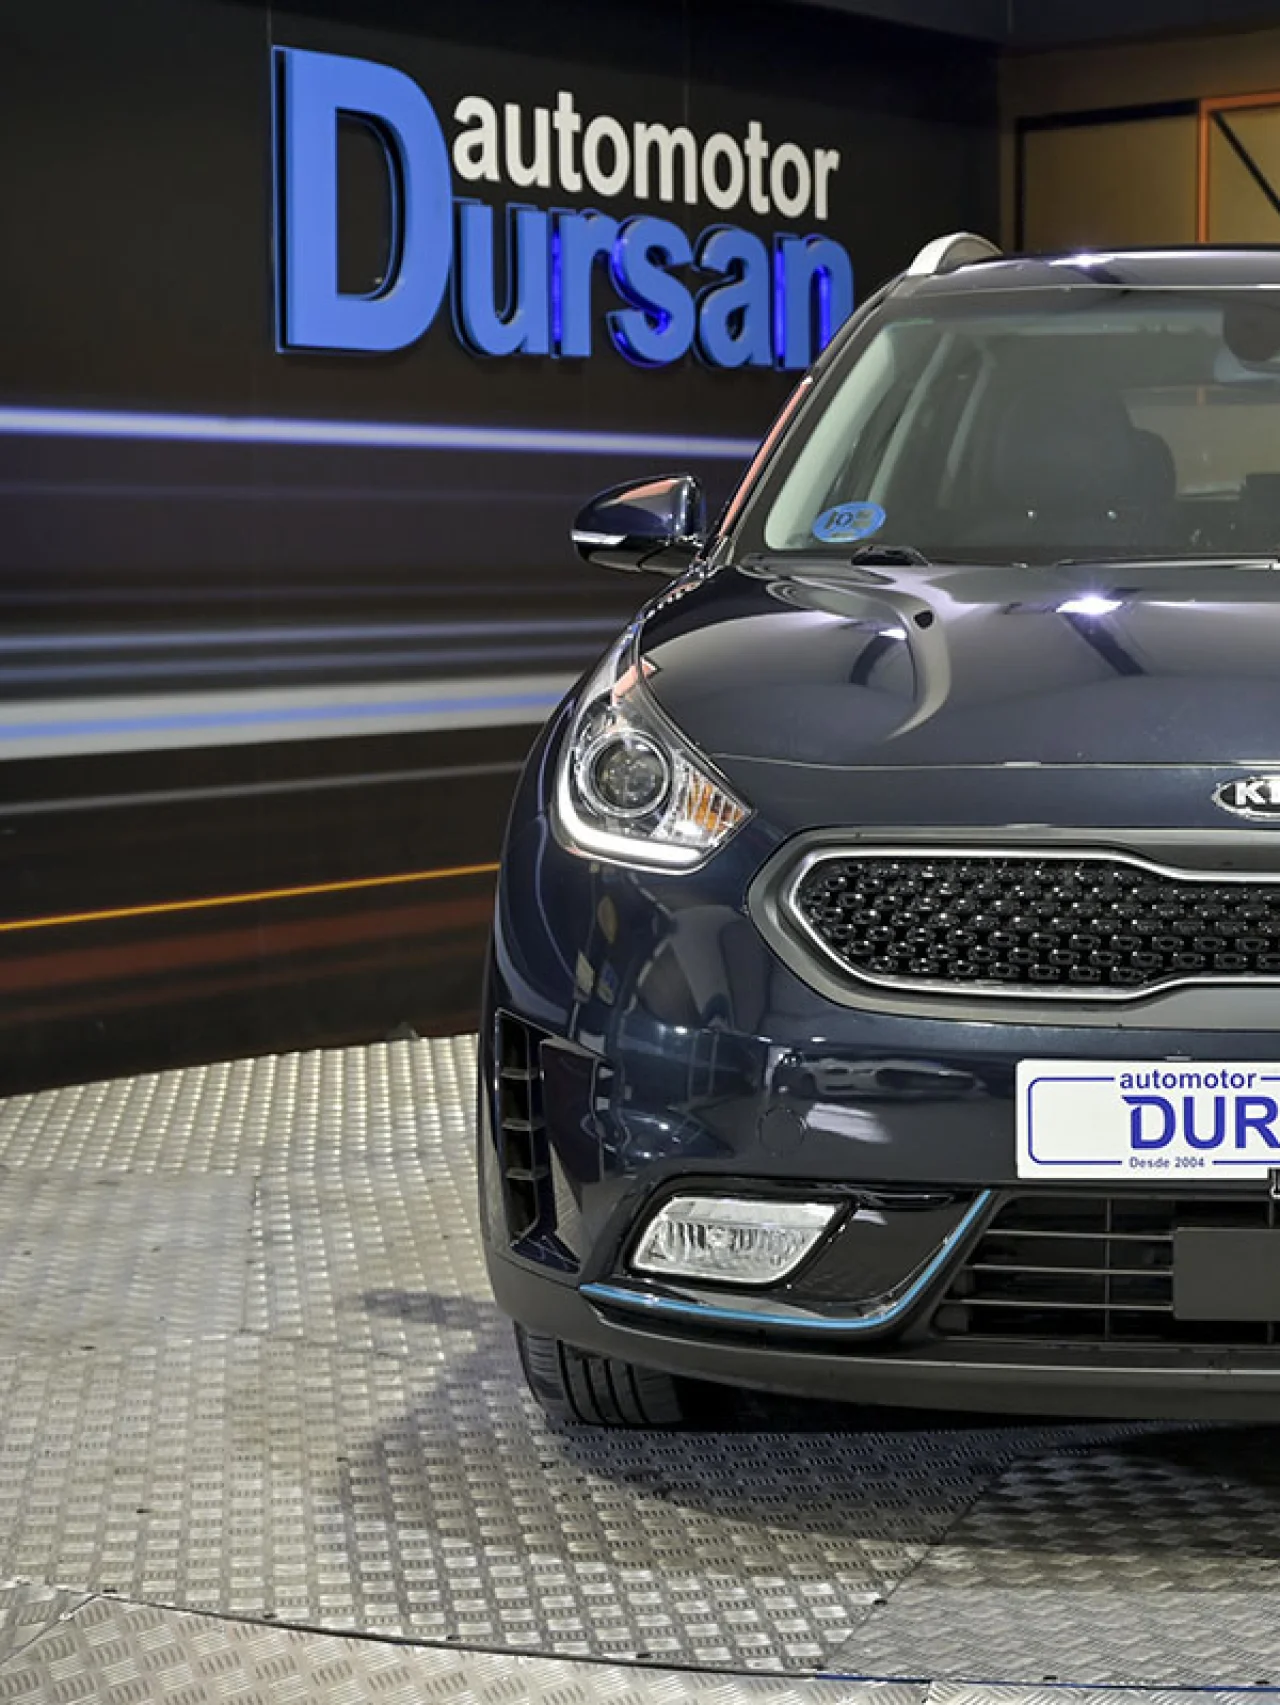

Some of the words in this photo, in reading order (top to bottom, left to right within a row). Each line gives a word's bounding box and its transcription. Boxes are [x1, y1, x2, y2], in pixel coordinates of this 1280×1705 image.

[454, 91, 839, 220] automotor
[272, 44, 855, 370] Dursan
[1119, 1068, 1257, 1090] automotor
[1129, 1156, 1170, 1168] Desde
[1174, 1156, 1205, 1168] 2004
